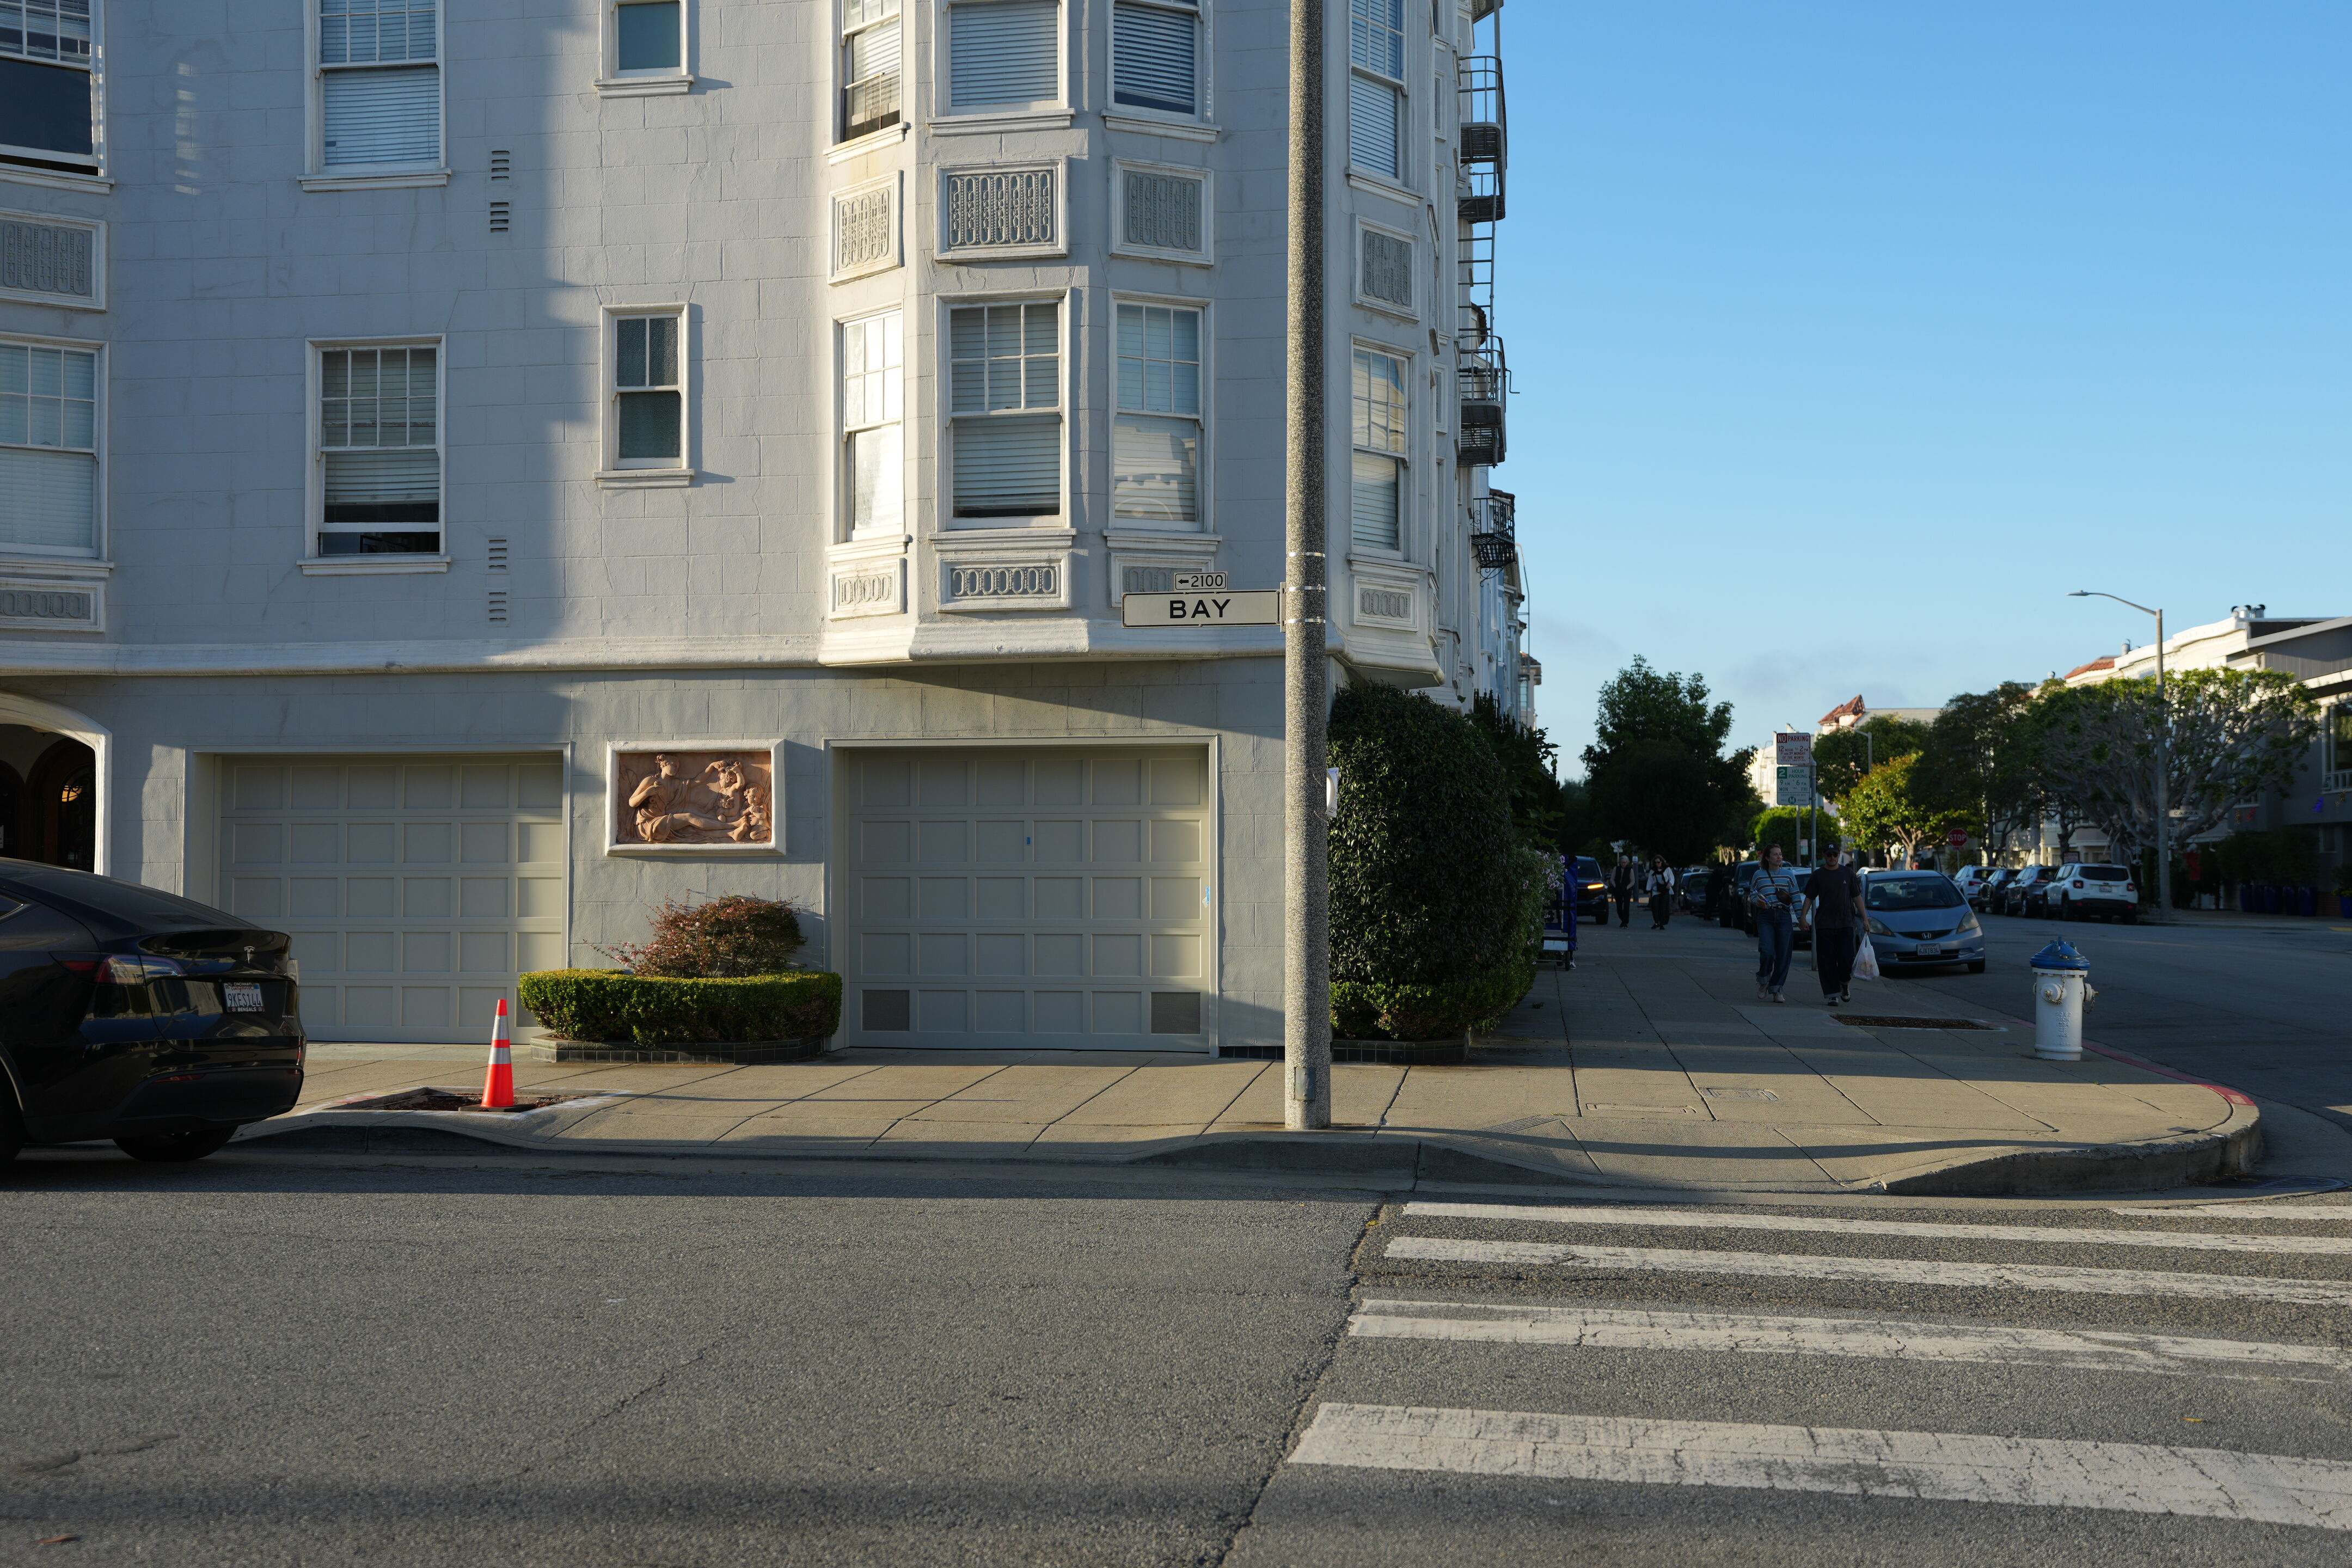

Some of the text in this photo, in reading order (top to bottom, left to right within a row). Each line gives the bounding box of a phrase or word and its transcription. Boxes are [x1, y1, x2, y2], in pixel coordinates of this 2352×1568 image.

[1191, 574, 1223, 587] 2100
[1169, 599, 1231, 618] BAY
[1777, 734, 1786, 742] NO
[1778, 769, 1786, 777] 2
[228, 993, 262, 1007] 9KES144
